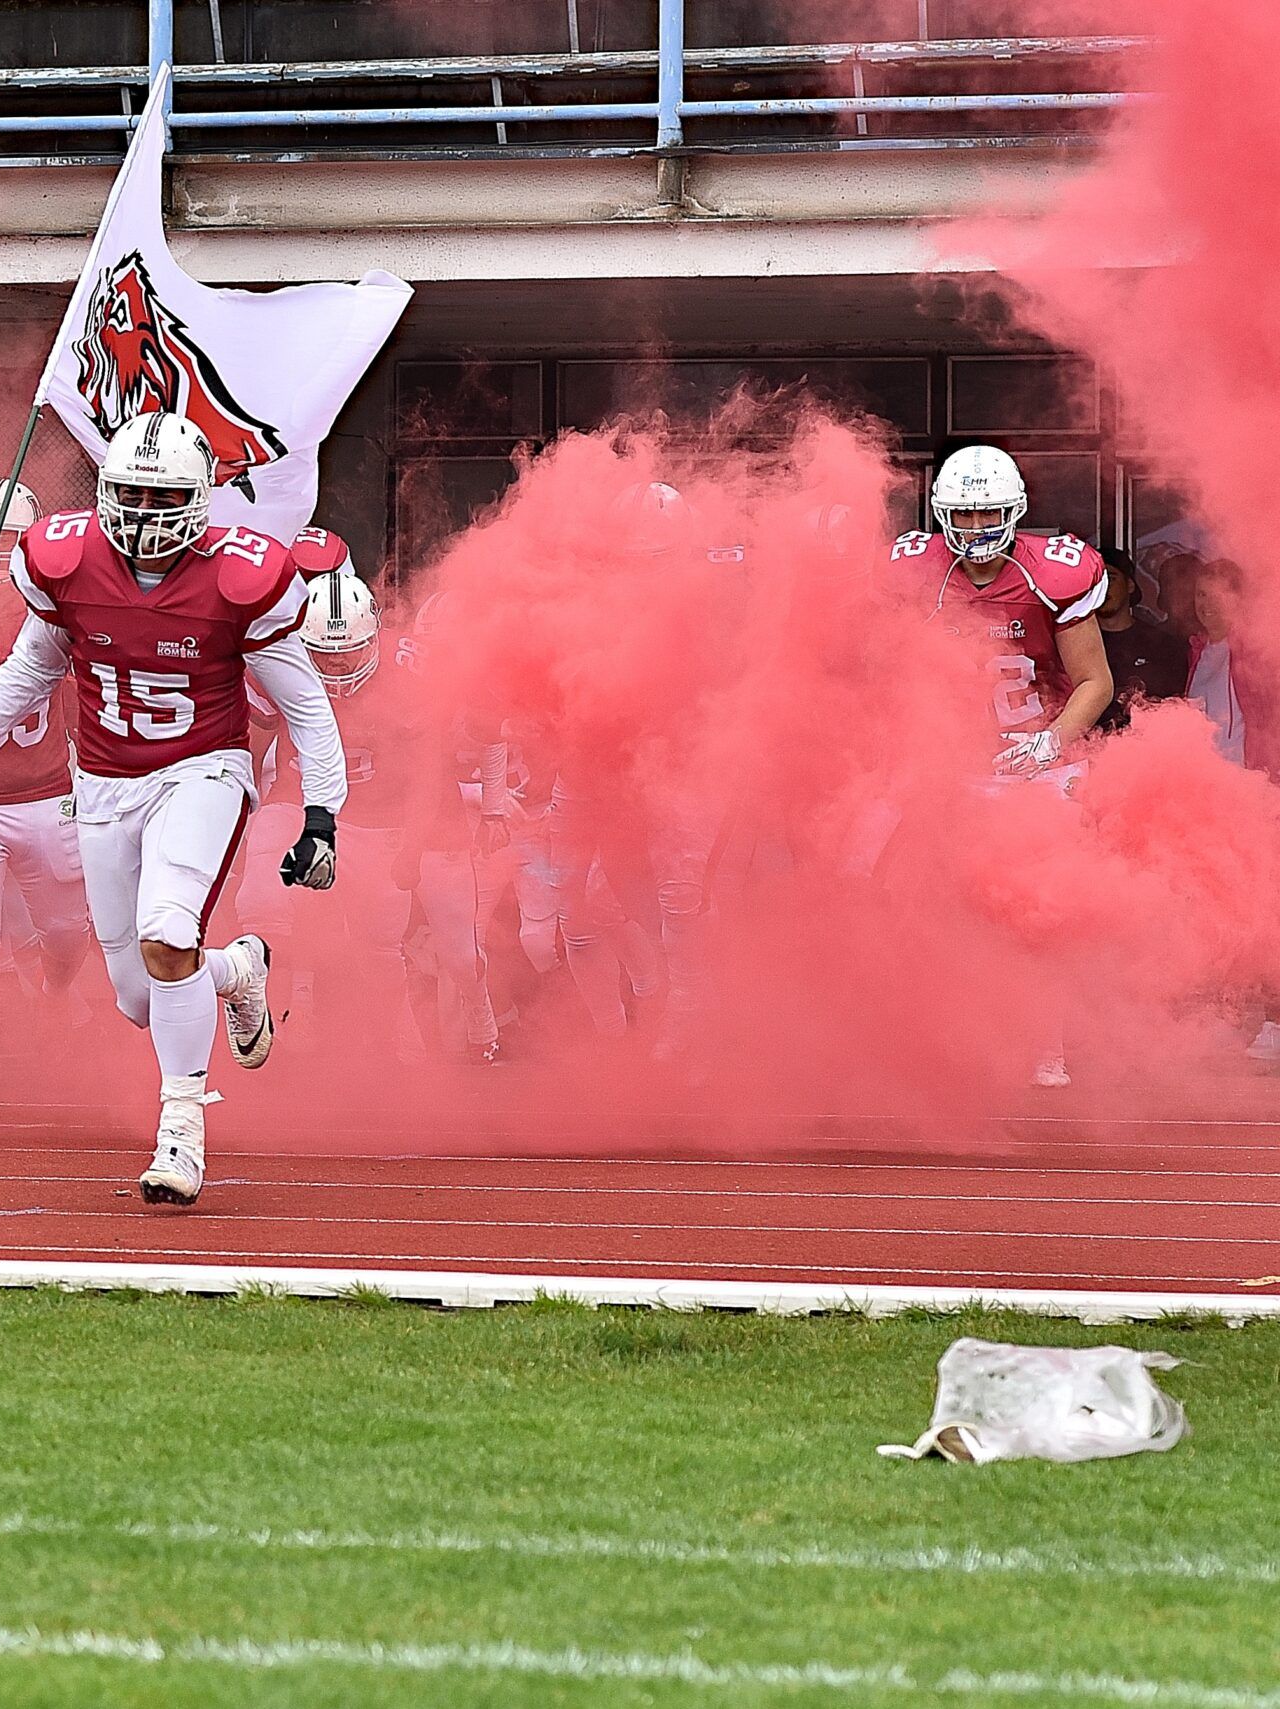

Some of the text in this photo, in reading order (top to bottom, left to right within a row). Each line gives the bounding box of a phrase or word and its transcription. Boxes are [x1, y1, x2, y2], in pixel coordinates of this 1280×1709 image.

[135, 446, 160, 460] MPI
[135, 464, 159, 473] Riddell
[45, 511, 93, 541] 15
[296, 527, 328, 547] 13
[223, 526, 270, 567] 15
[890, 530, 933, 561] 62
[1043, 535, 1086, 567] 62
[327, 620, 347, 630] MPI
[89, 662, 196, 741] 15
